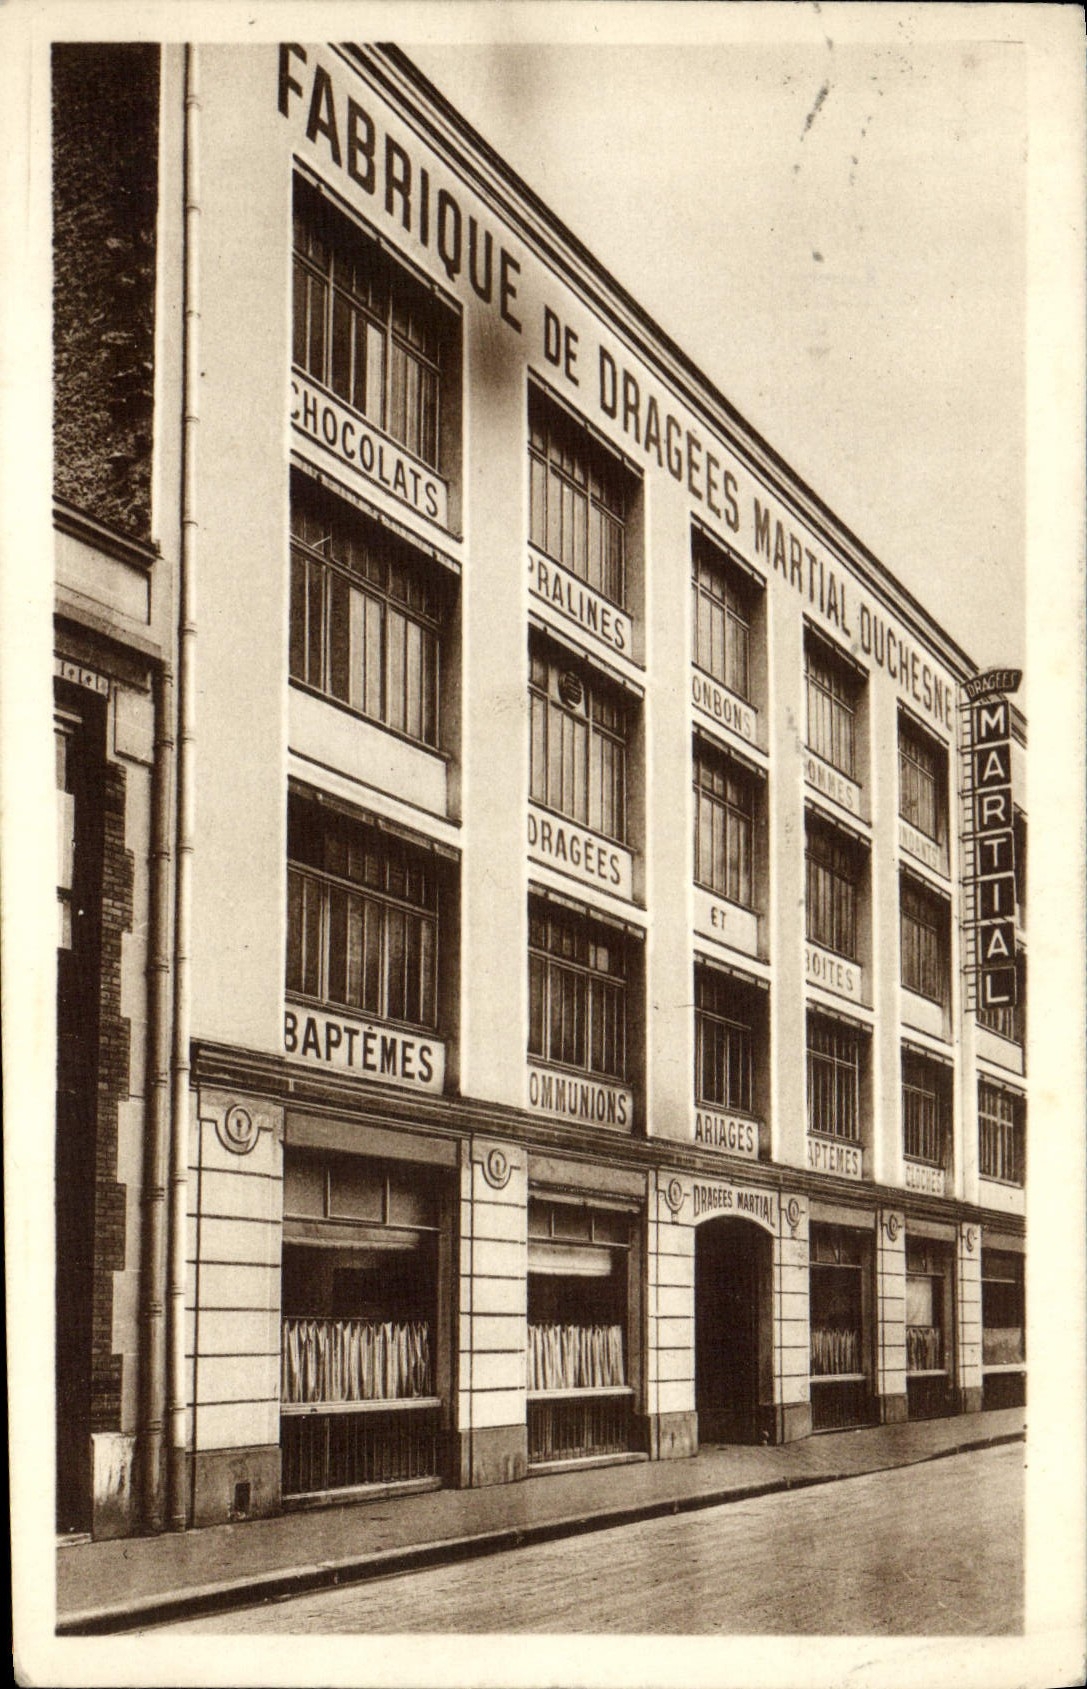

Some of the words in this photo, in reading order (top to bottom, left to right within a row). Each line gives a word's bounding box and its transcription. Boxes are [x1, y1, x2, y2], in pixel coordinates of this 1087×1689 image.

[277, 42, 522, 335] FABRIQUE
[544, 304, 580, 388] DE
[599, 344, 739, 534] DRAGEES
[753, 497, 851, 638] MARTIAL
[860, 602, 953, 733] DUCHESNE
[804, 759, 854, 809] OMMES
[981, 704, 1010, 1004] MARTIAL
[711, 906, 727, 931] ET
[284, 1010, 434, 1084] BAPTÊMES
[737, 1191, 777, 1229] MARTIAL
